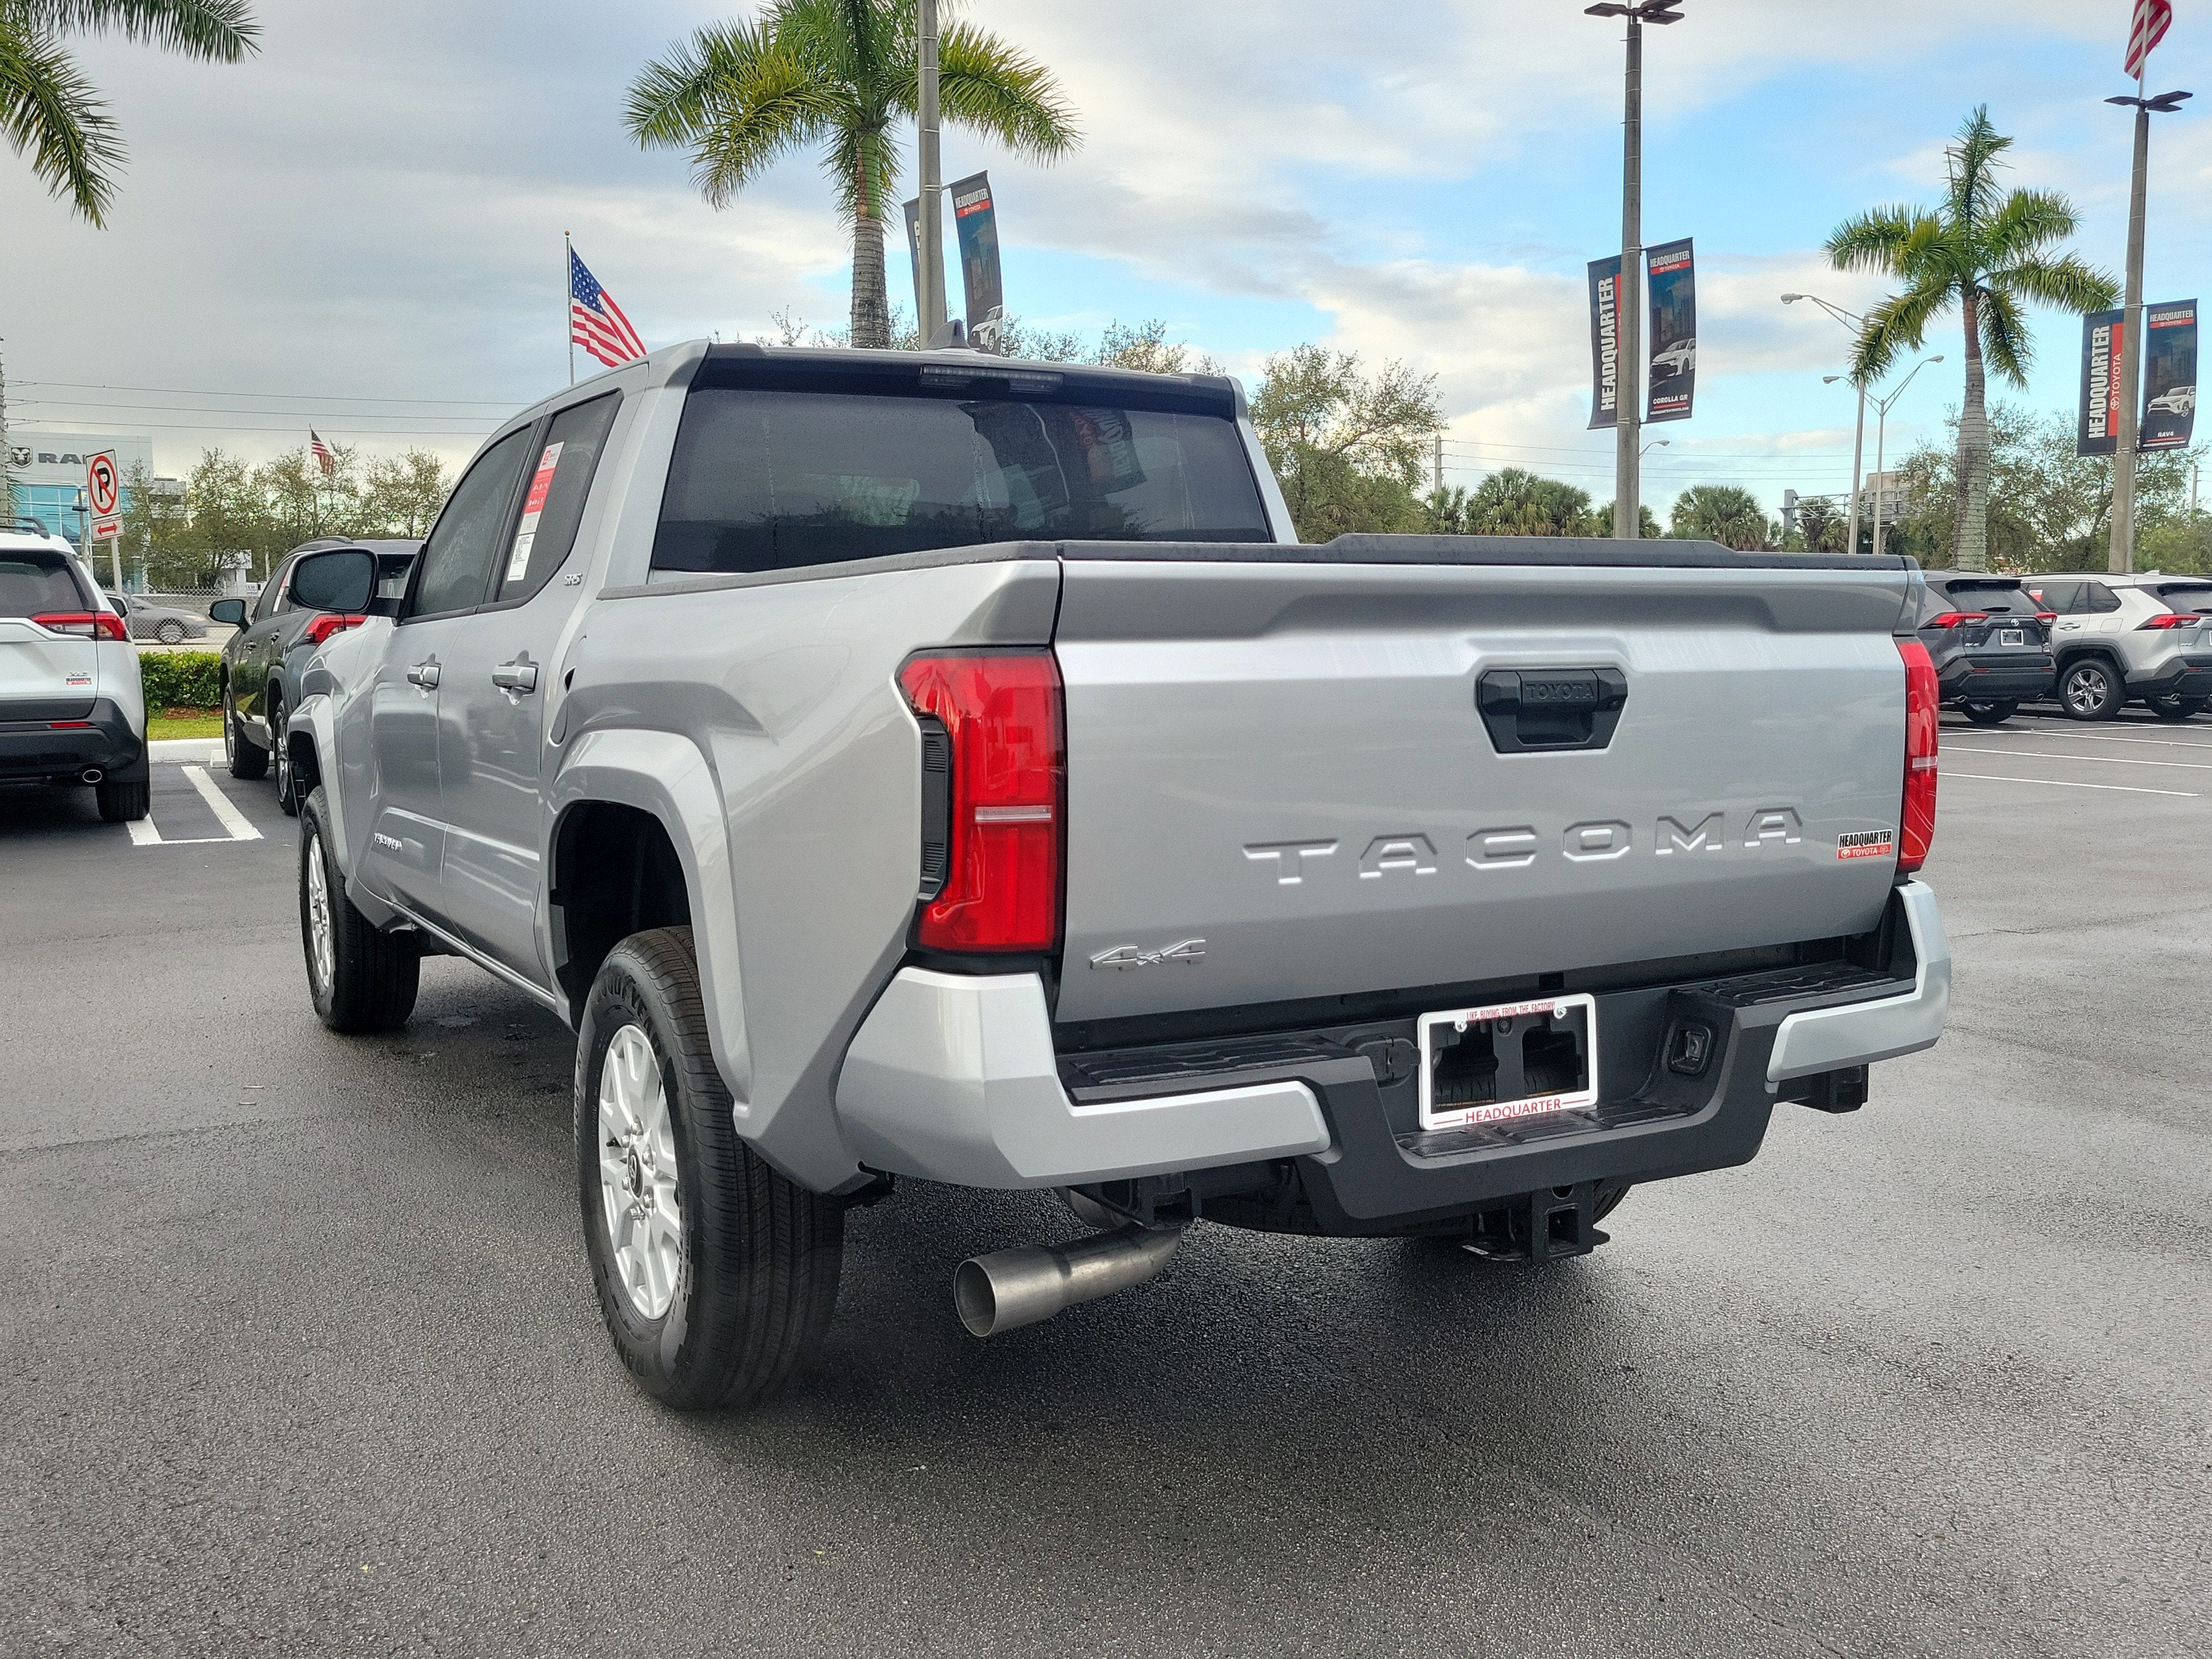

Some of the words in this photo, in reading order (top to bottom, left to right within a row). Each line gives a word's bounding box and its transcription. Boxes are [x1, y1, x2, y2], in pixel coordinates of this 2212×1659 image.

[955, 188, 989, 209] HEADQUARTER
[968, 204, 981, 212] TOYOTA
[1650, 250, 1690, 268] HEADQUARTER
[2149, 310, 2193, 322] HEADQUARTER
[1598, 276, 1618, 411] HEADQUARTER
[2088, 326, 2111, 438] HEADQUARTER
[2112, 353, 2121, 396] TOYOTA
[1653, 395, 1679, 404] COROLLA
[38, 453, 86, 464] RA
[564, 573, 583, 586] SR5
[1525, 683, 1595, 699] TOYOTA
[1242, 806, 1803, 884] TACOMA
[1839, 831, 1892, 848] HEADQUARTER
[1852, 847, 1878, 857] TOYOTA
[1090, 938, 1206, 971] 4x4
[1466, 1011, 1478, 1021] LIKE
[1480, 1008, 1500, 1019] BUYING
[1502, 1006, 1517, 1017] FROM
[1519, 1005, 1530, 1014] THE
[1531, 1001, 1556, 1012] FACTORY!
[1466, 1098, 1561, 1124] HEADQUARTER
